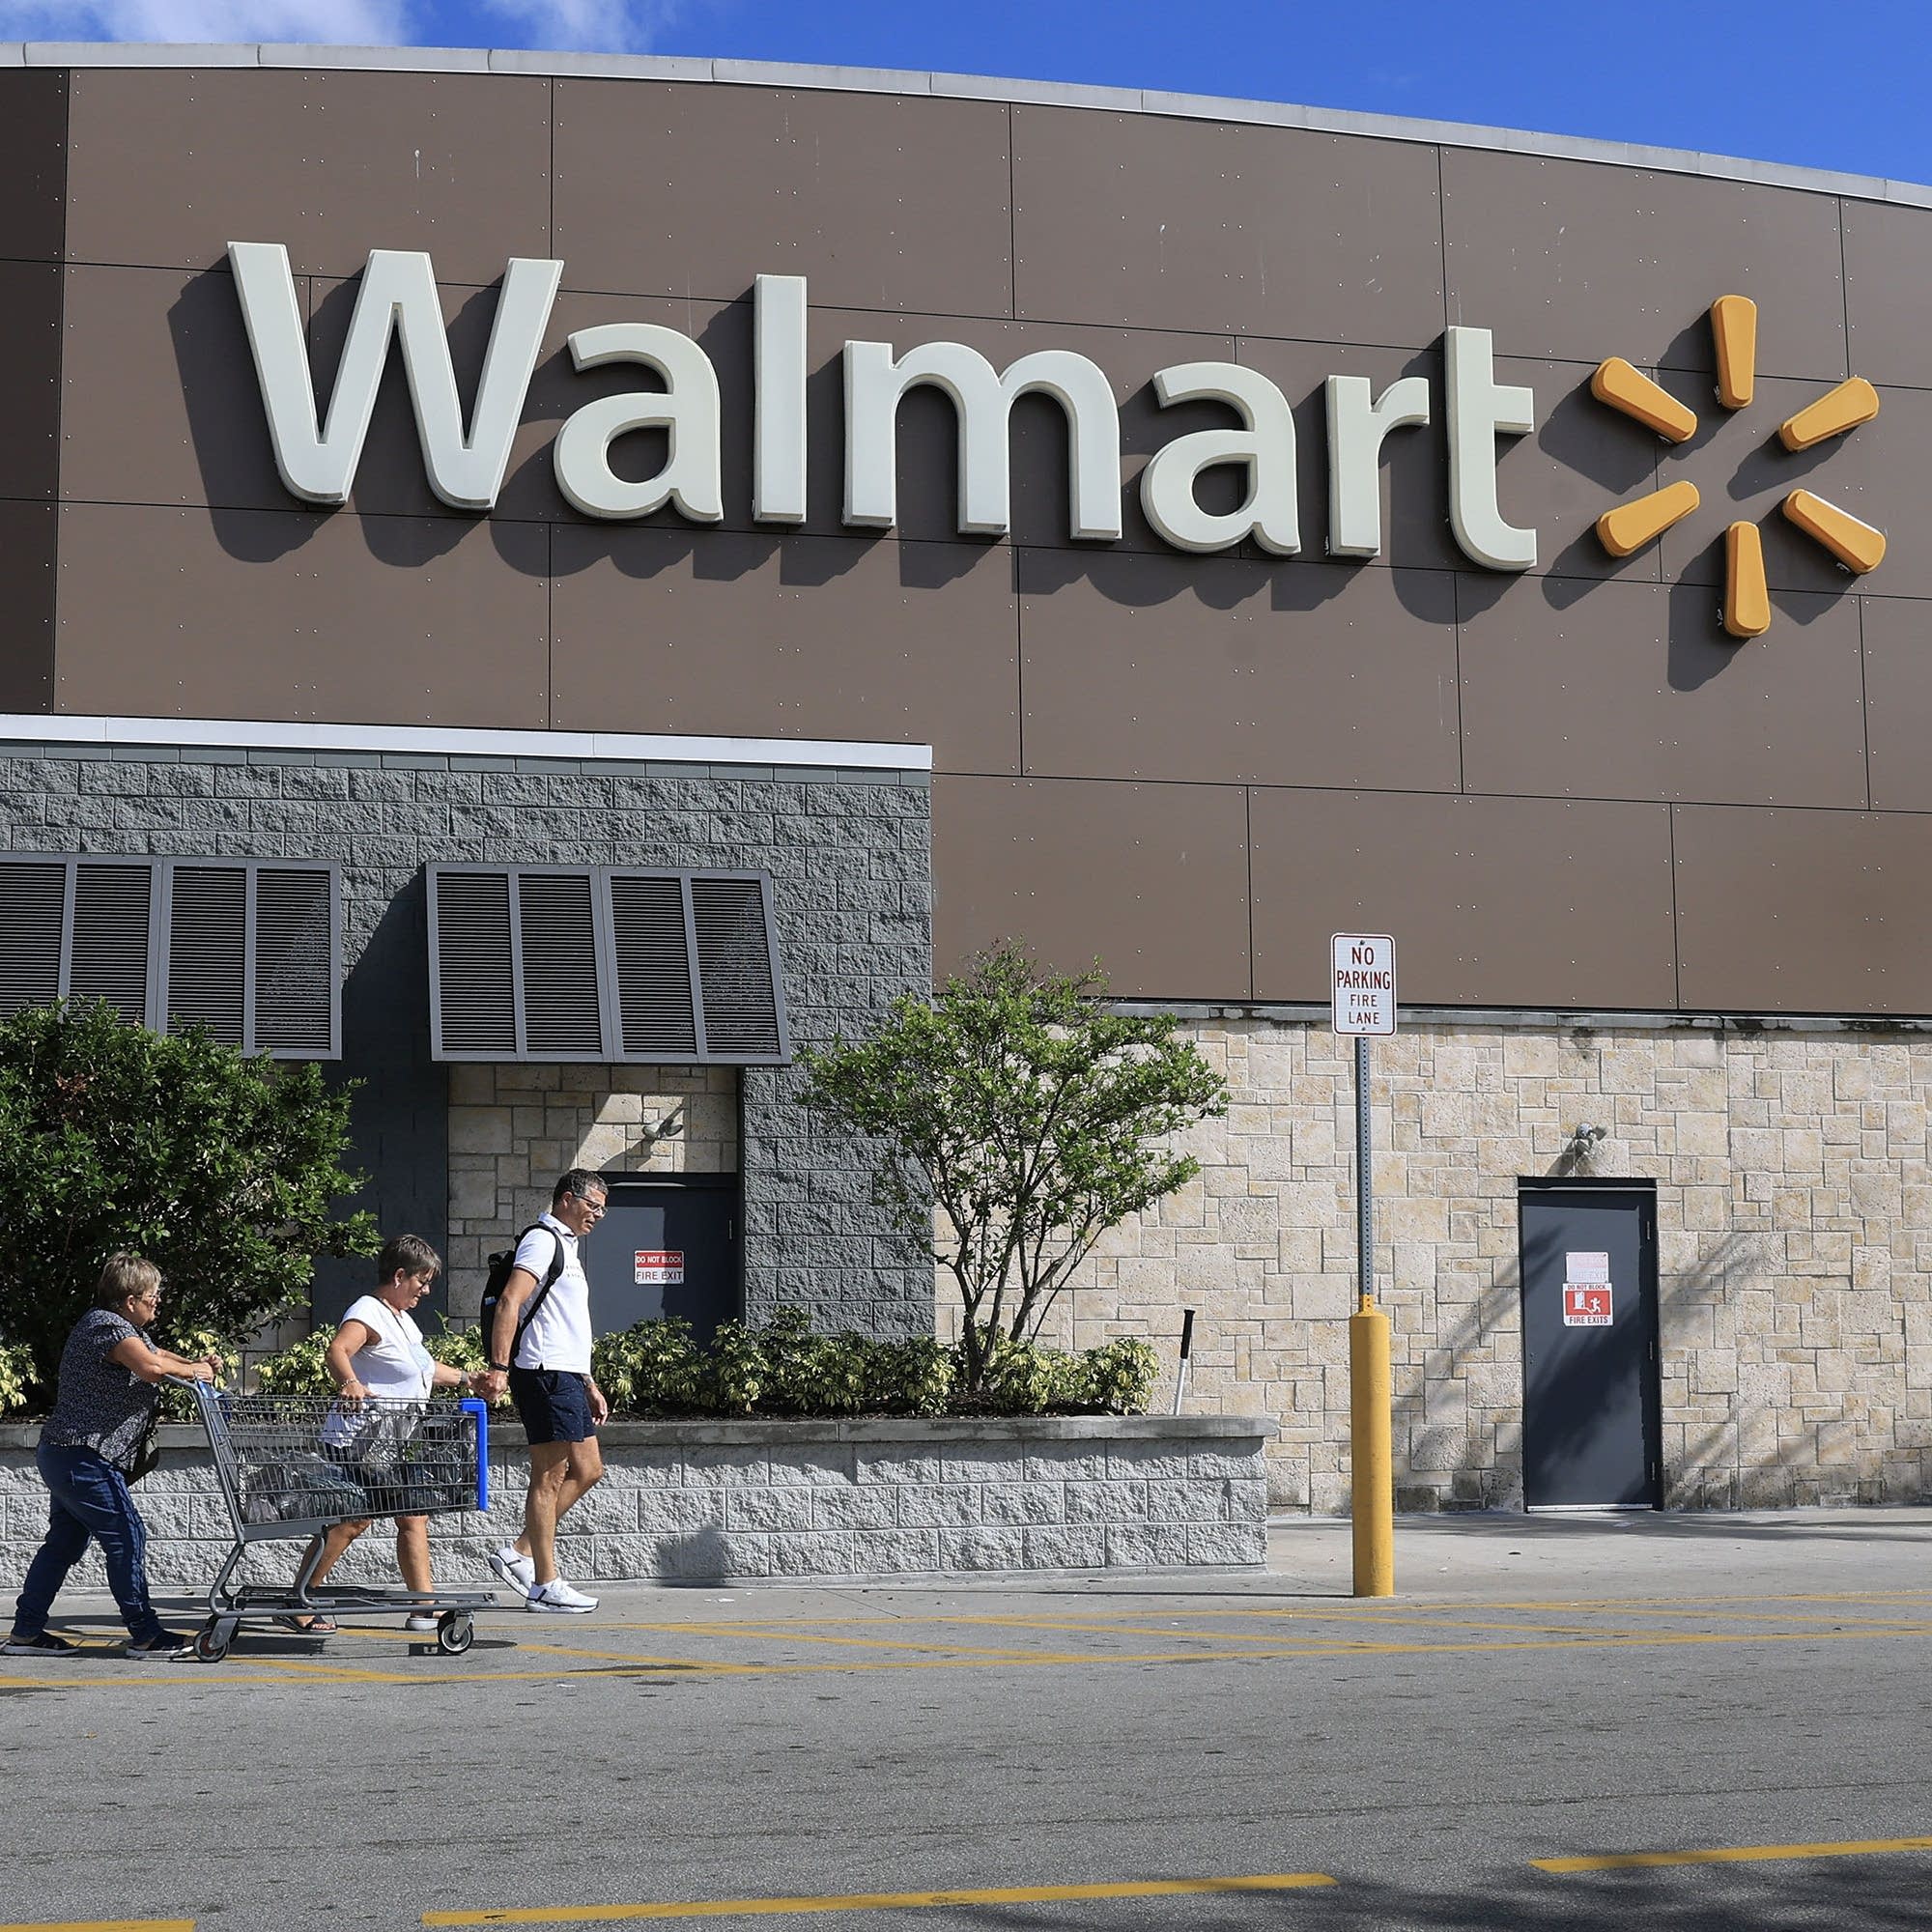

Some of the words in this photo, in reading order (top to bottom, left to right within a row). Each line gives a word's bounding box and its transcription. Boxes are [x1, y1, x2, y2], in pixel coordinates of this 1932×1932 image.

[226, 240, 1539, 573] Walmart
[1351, 947, 1375, 965] NO
[1337, 970, 1391, 989] PARKING
[1350, 994, 1378, 1007] FIRE
[1349, 1011, 1379, 1024] LANE
[637, 1271, 657, 1280] FIRE
[662, 1271, 682, 1280] EXIT
[1570, 1316, 1585, 1324] FIRE
[1587, 1316, 1608, 1324] EXITS
